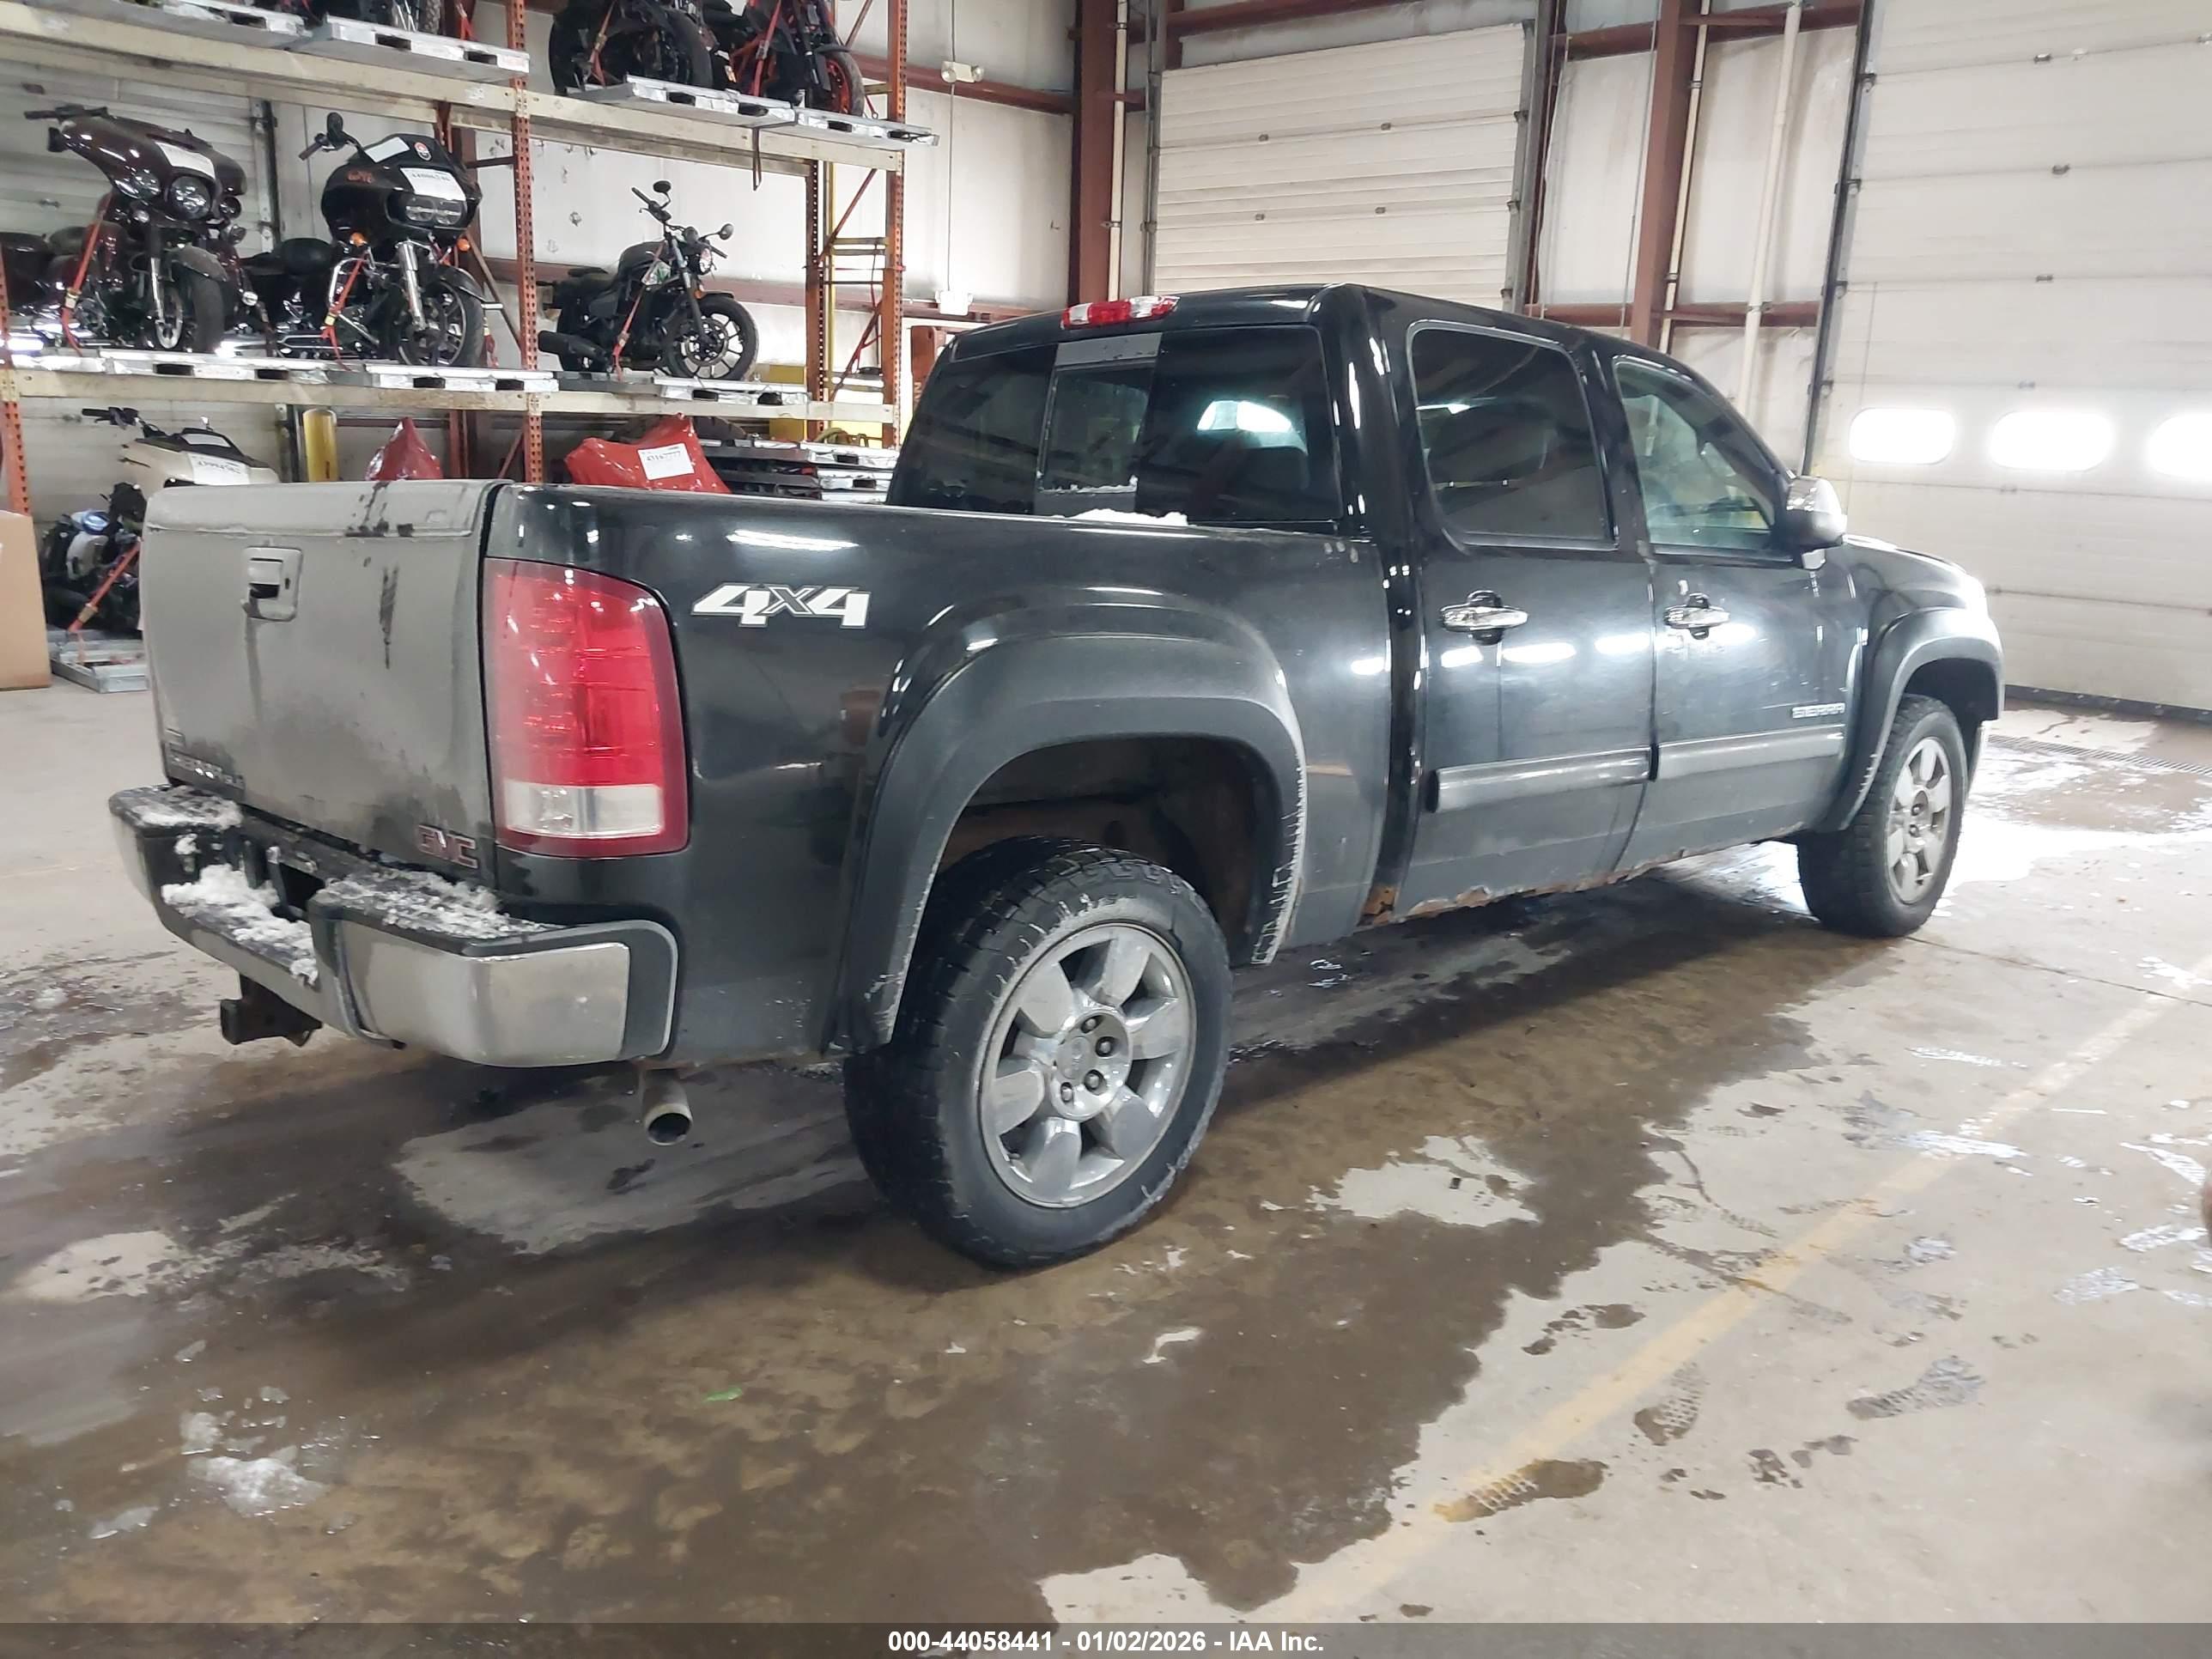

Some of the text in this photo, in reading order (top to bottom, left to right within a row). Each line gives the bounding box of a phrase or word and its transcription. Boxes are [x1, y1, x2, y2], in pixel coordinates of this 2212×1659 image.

[691, 582, 872, 629] 4X4
[1792, 702, 1845, 719] SIERRA
[418, 824, 478, 869] GMC
